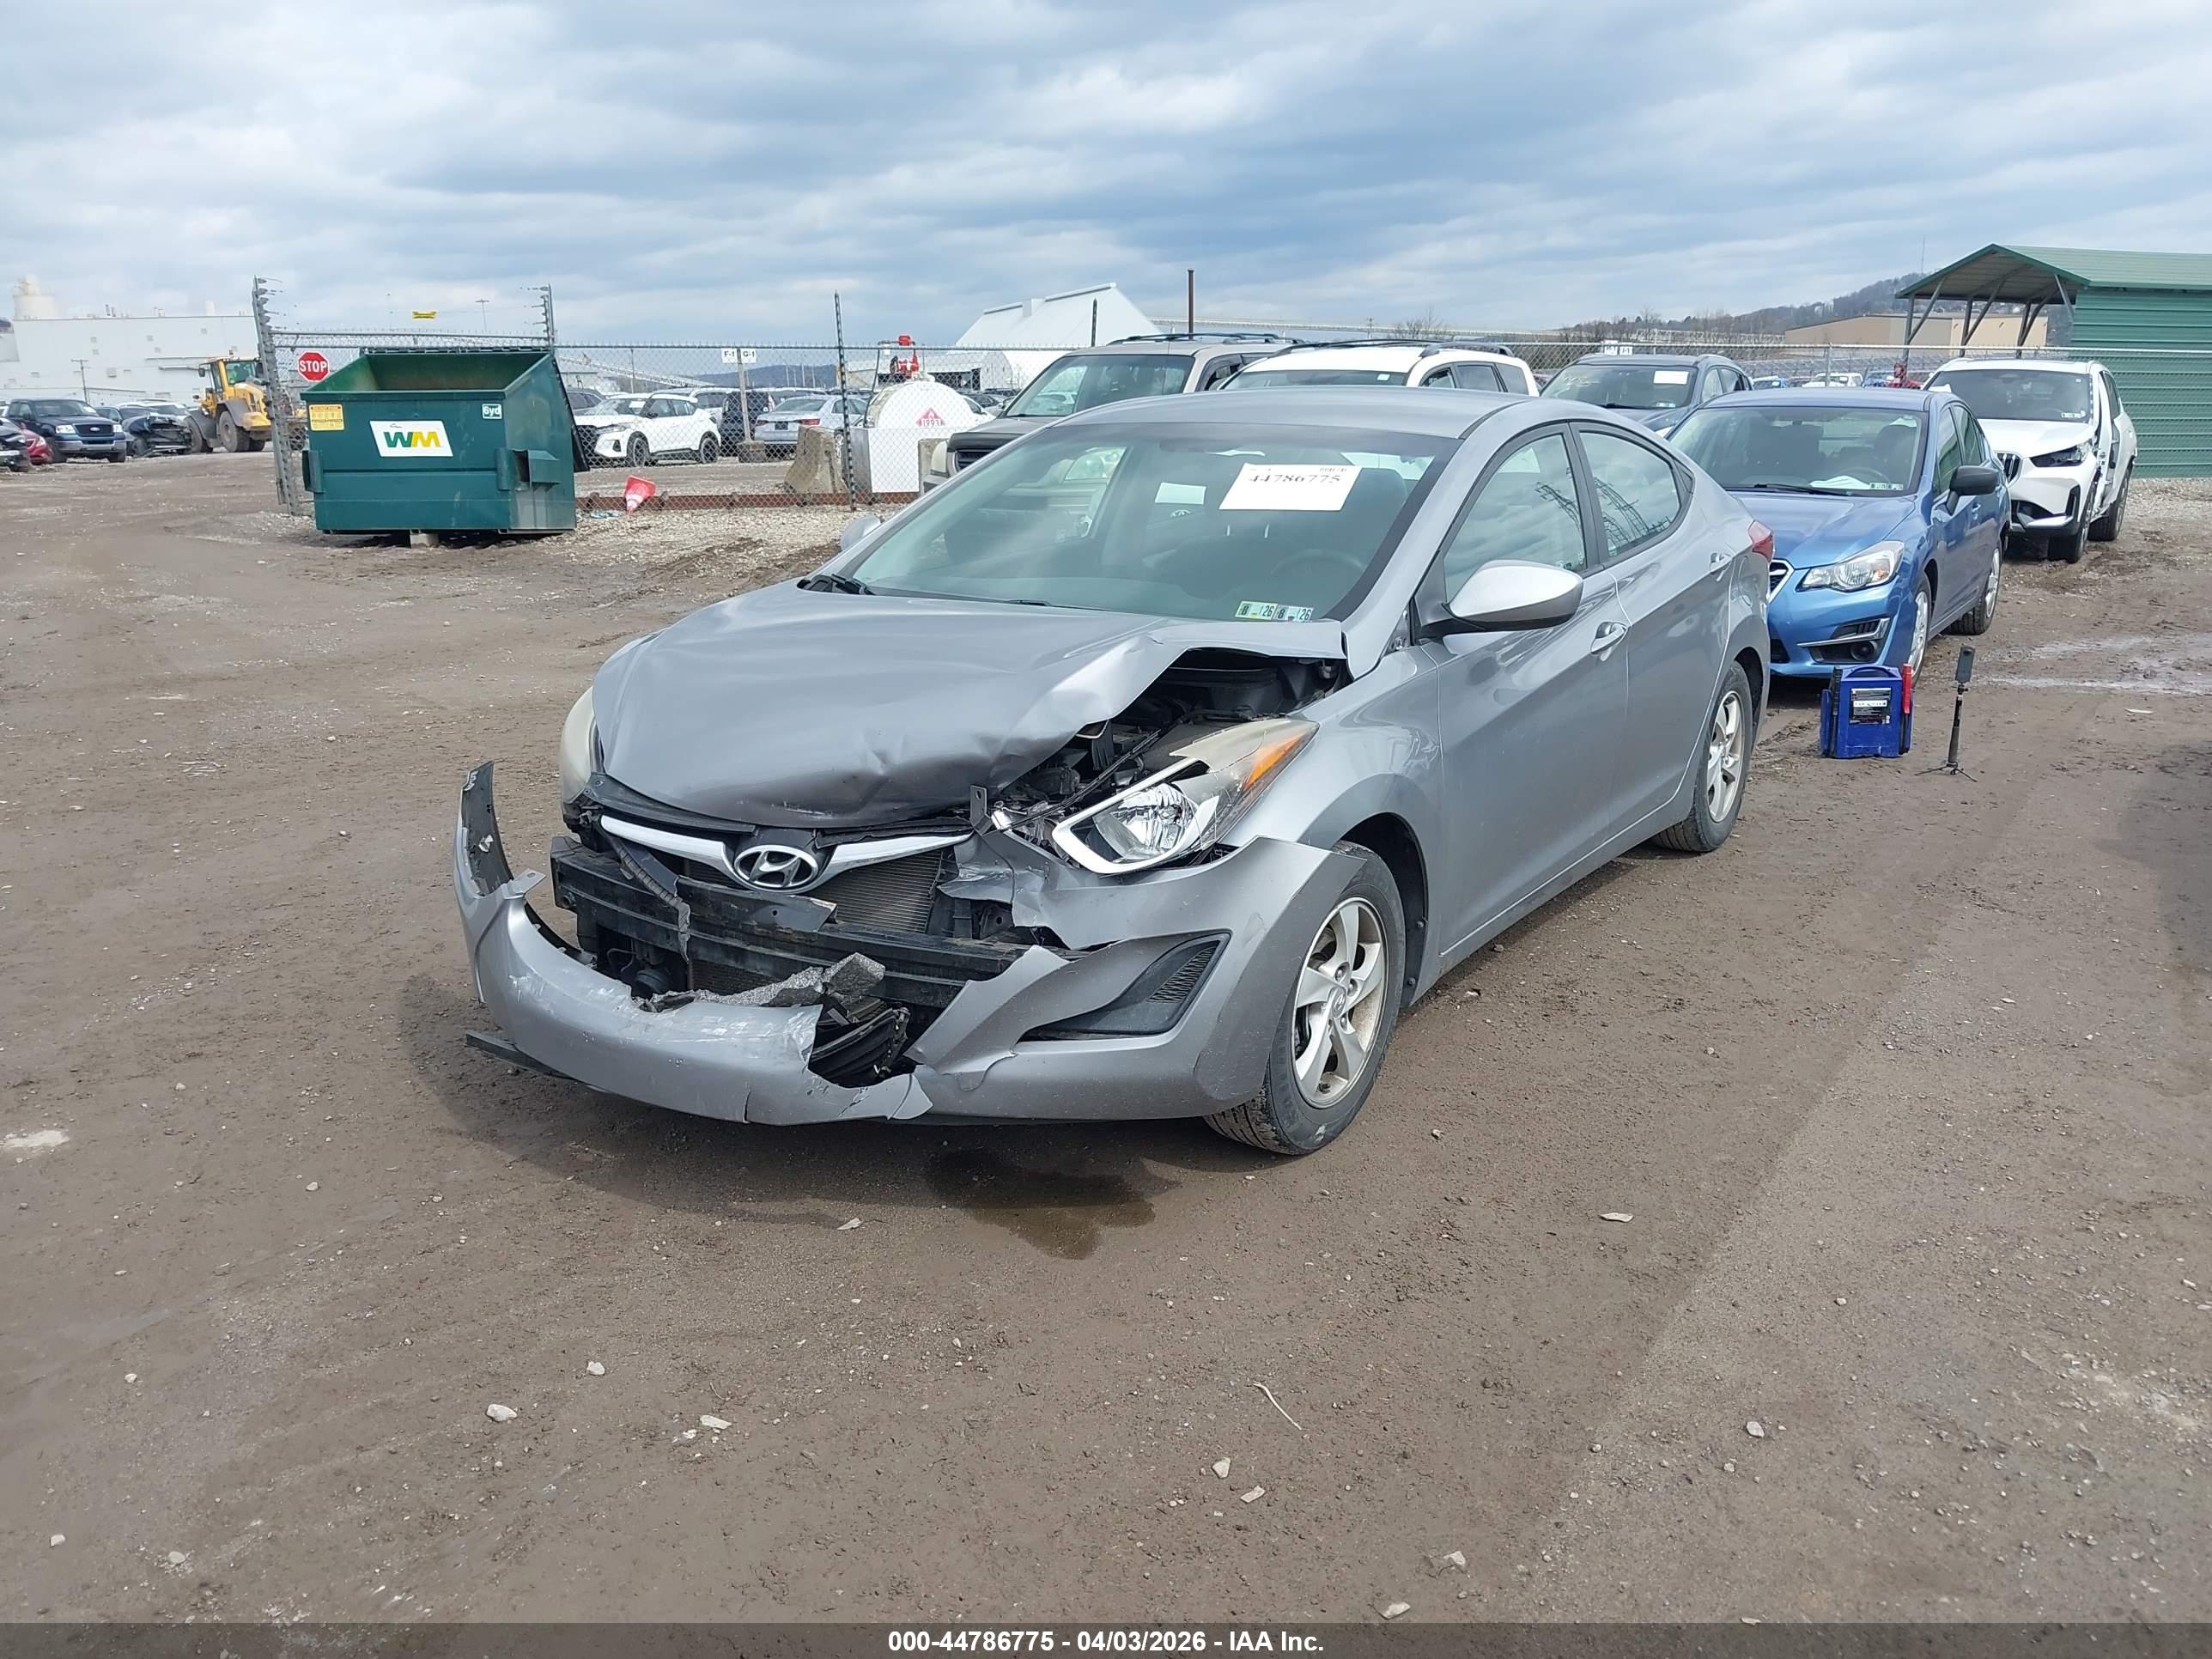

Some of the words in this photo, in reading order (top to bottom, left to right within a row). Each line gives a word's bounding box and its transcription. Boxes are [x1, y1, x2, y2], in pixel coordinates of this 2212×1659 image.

[300, 360, 327, 373] STOP
[384, 431, 441, 447] WM
[1249, 474, 1341, 483] 44786775
[1263, 605, 1274, 617] 26
[1299, 608, 1311, 620] 26
